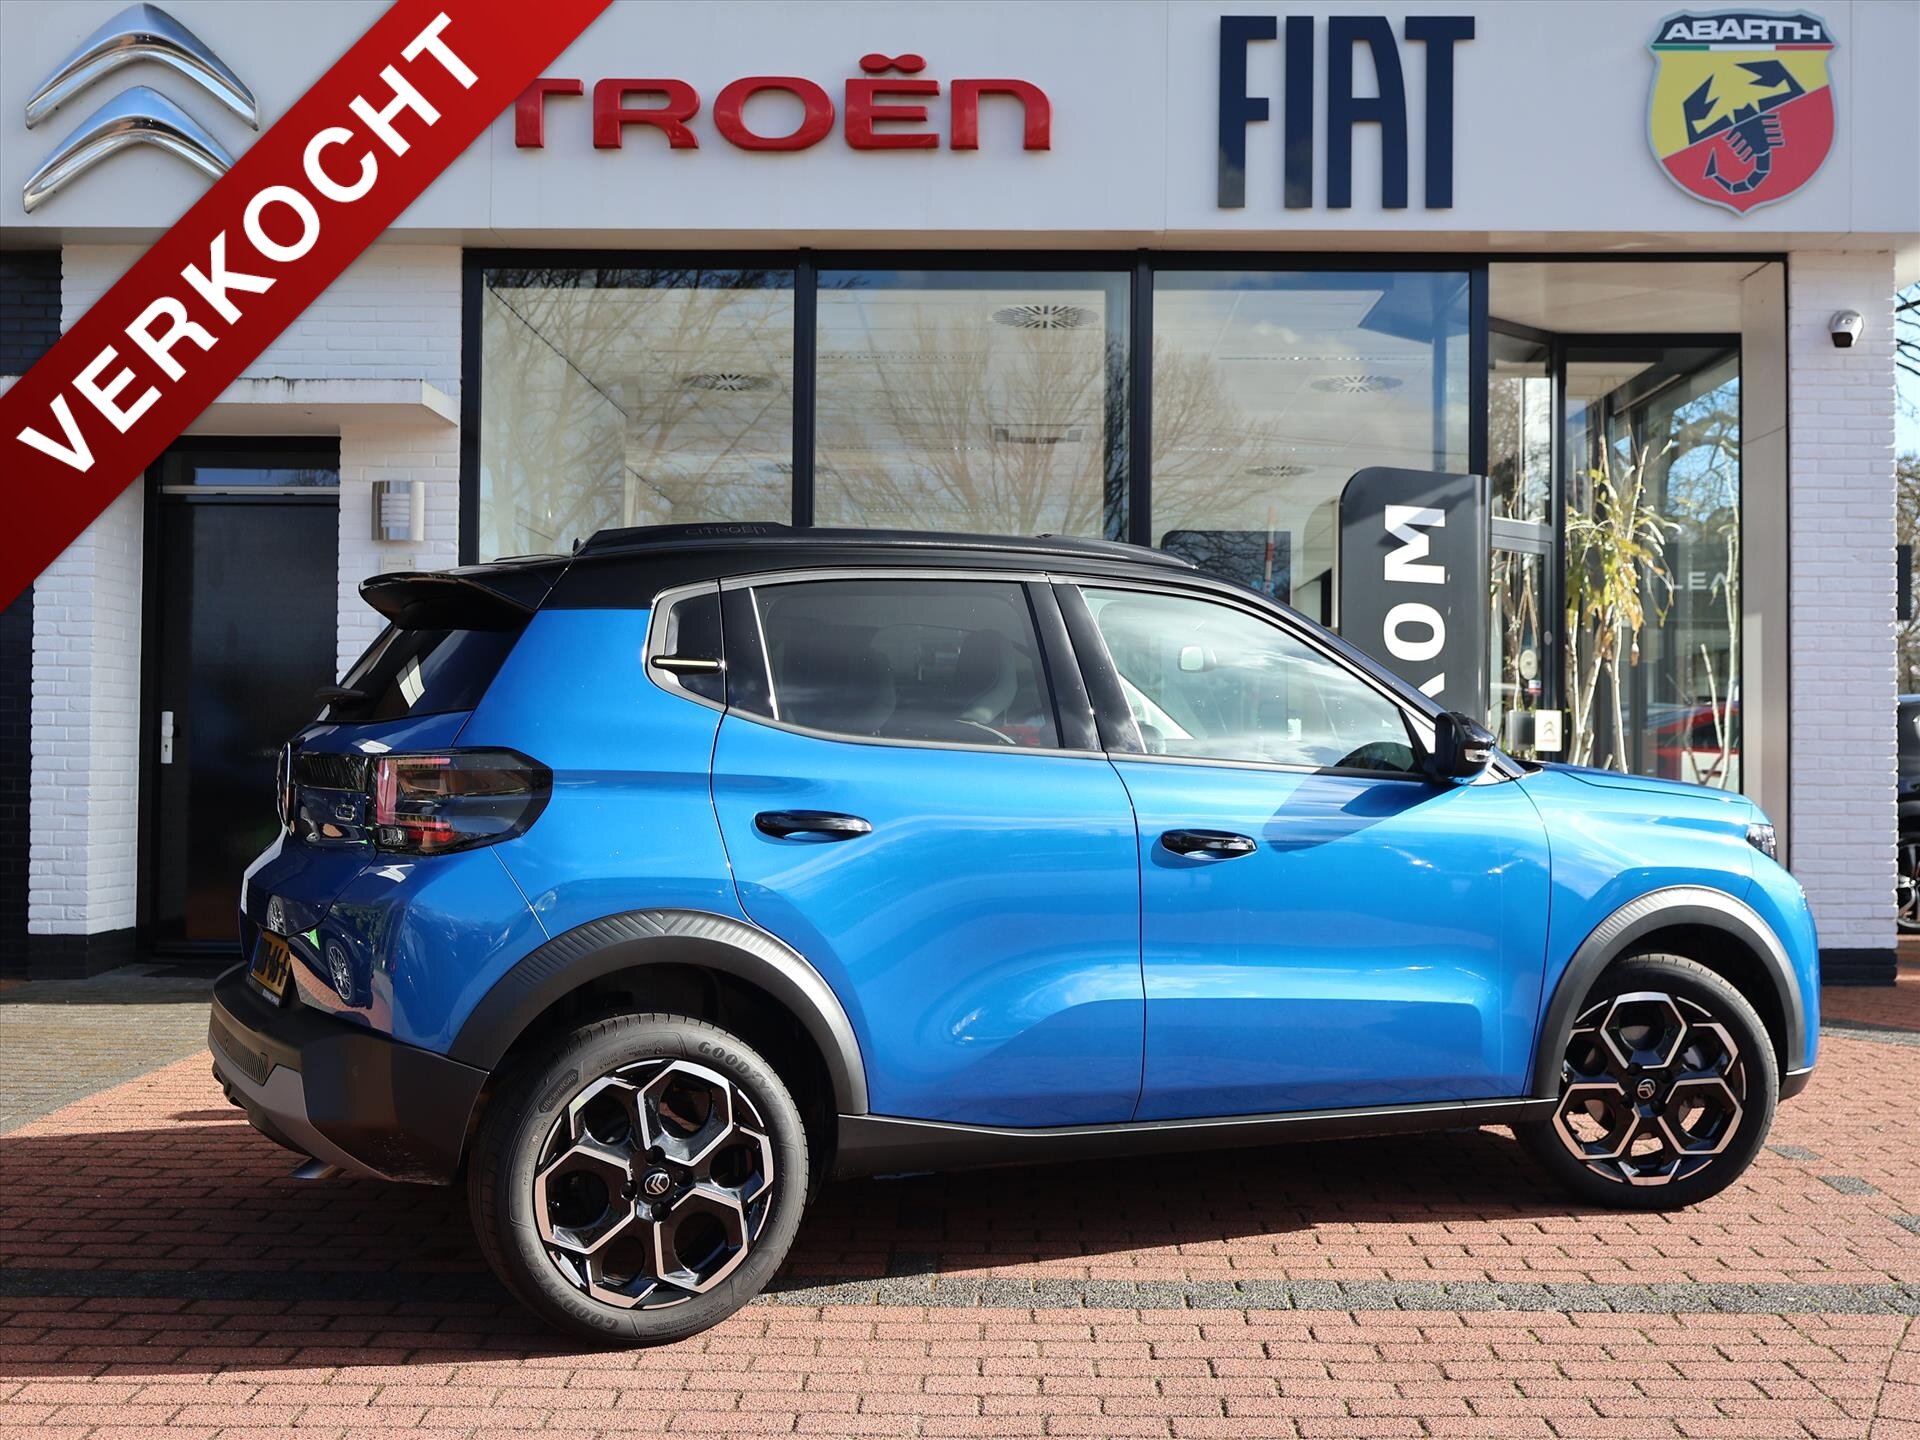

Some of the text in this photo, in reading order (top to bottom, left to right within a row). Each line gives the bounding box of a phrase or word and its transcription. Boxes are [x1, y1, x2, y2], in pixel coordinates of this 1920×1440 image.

[1664, 18, 1821, 41] ABARTH
[514, 53, 1052, 151] TROËN
[1217, 15, 1475, 208] FIAT
